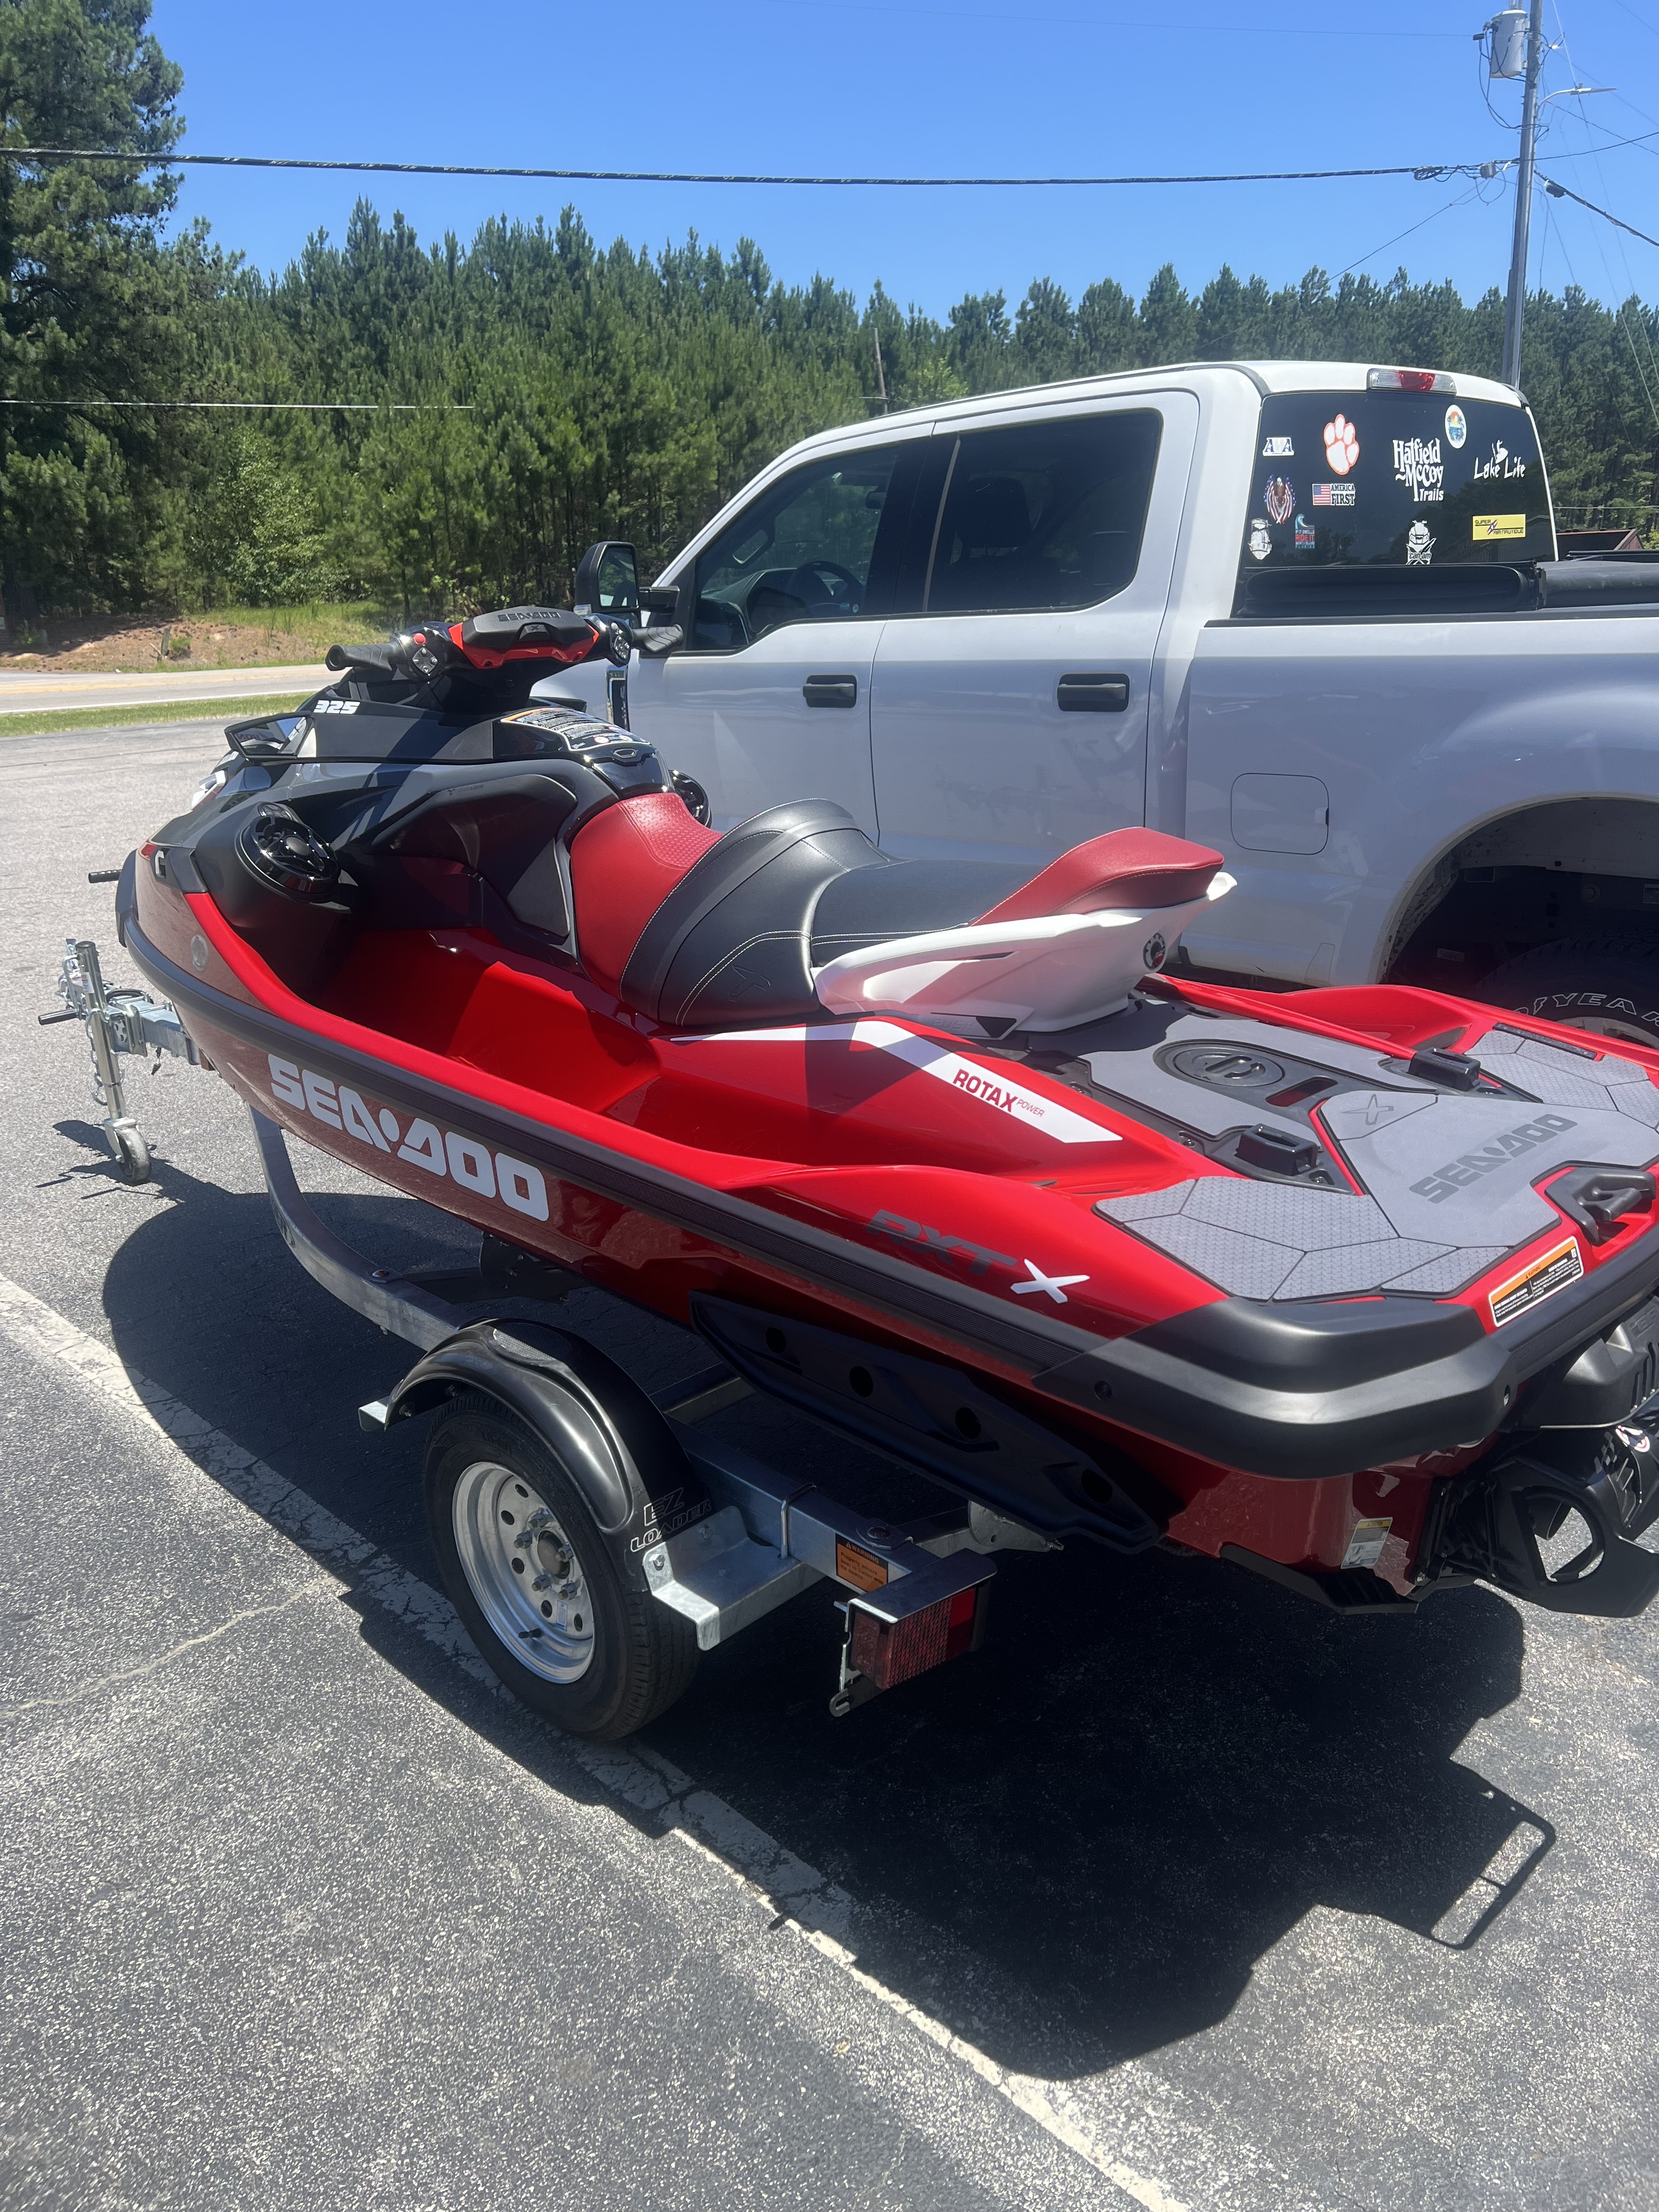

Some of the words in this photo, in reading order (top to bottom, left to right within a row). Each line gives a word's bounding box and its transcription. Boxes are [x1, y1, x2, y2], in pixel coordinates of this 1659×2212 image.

[1392, 437, 1441, 472] Hatfield
[1474, 457, 1500, 479] Lake
[1504, 456, 1526, 479] Life
[1331, 493, 1355, 505] FIRST
[1419, 488, 1444, 501] Trails
[313, 699, 360, 714] 325
[952, 1068, 1018, 1113] ROTAX
[1016, 1098, 1045, 1118] POWER
[865, 1209, 1018, 1276] RXT
[643, 1487, 685, 1527] EZ
[630, 1498, 712, 1553] LOADER
[851, 1544, 879, 1564] WARNING
